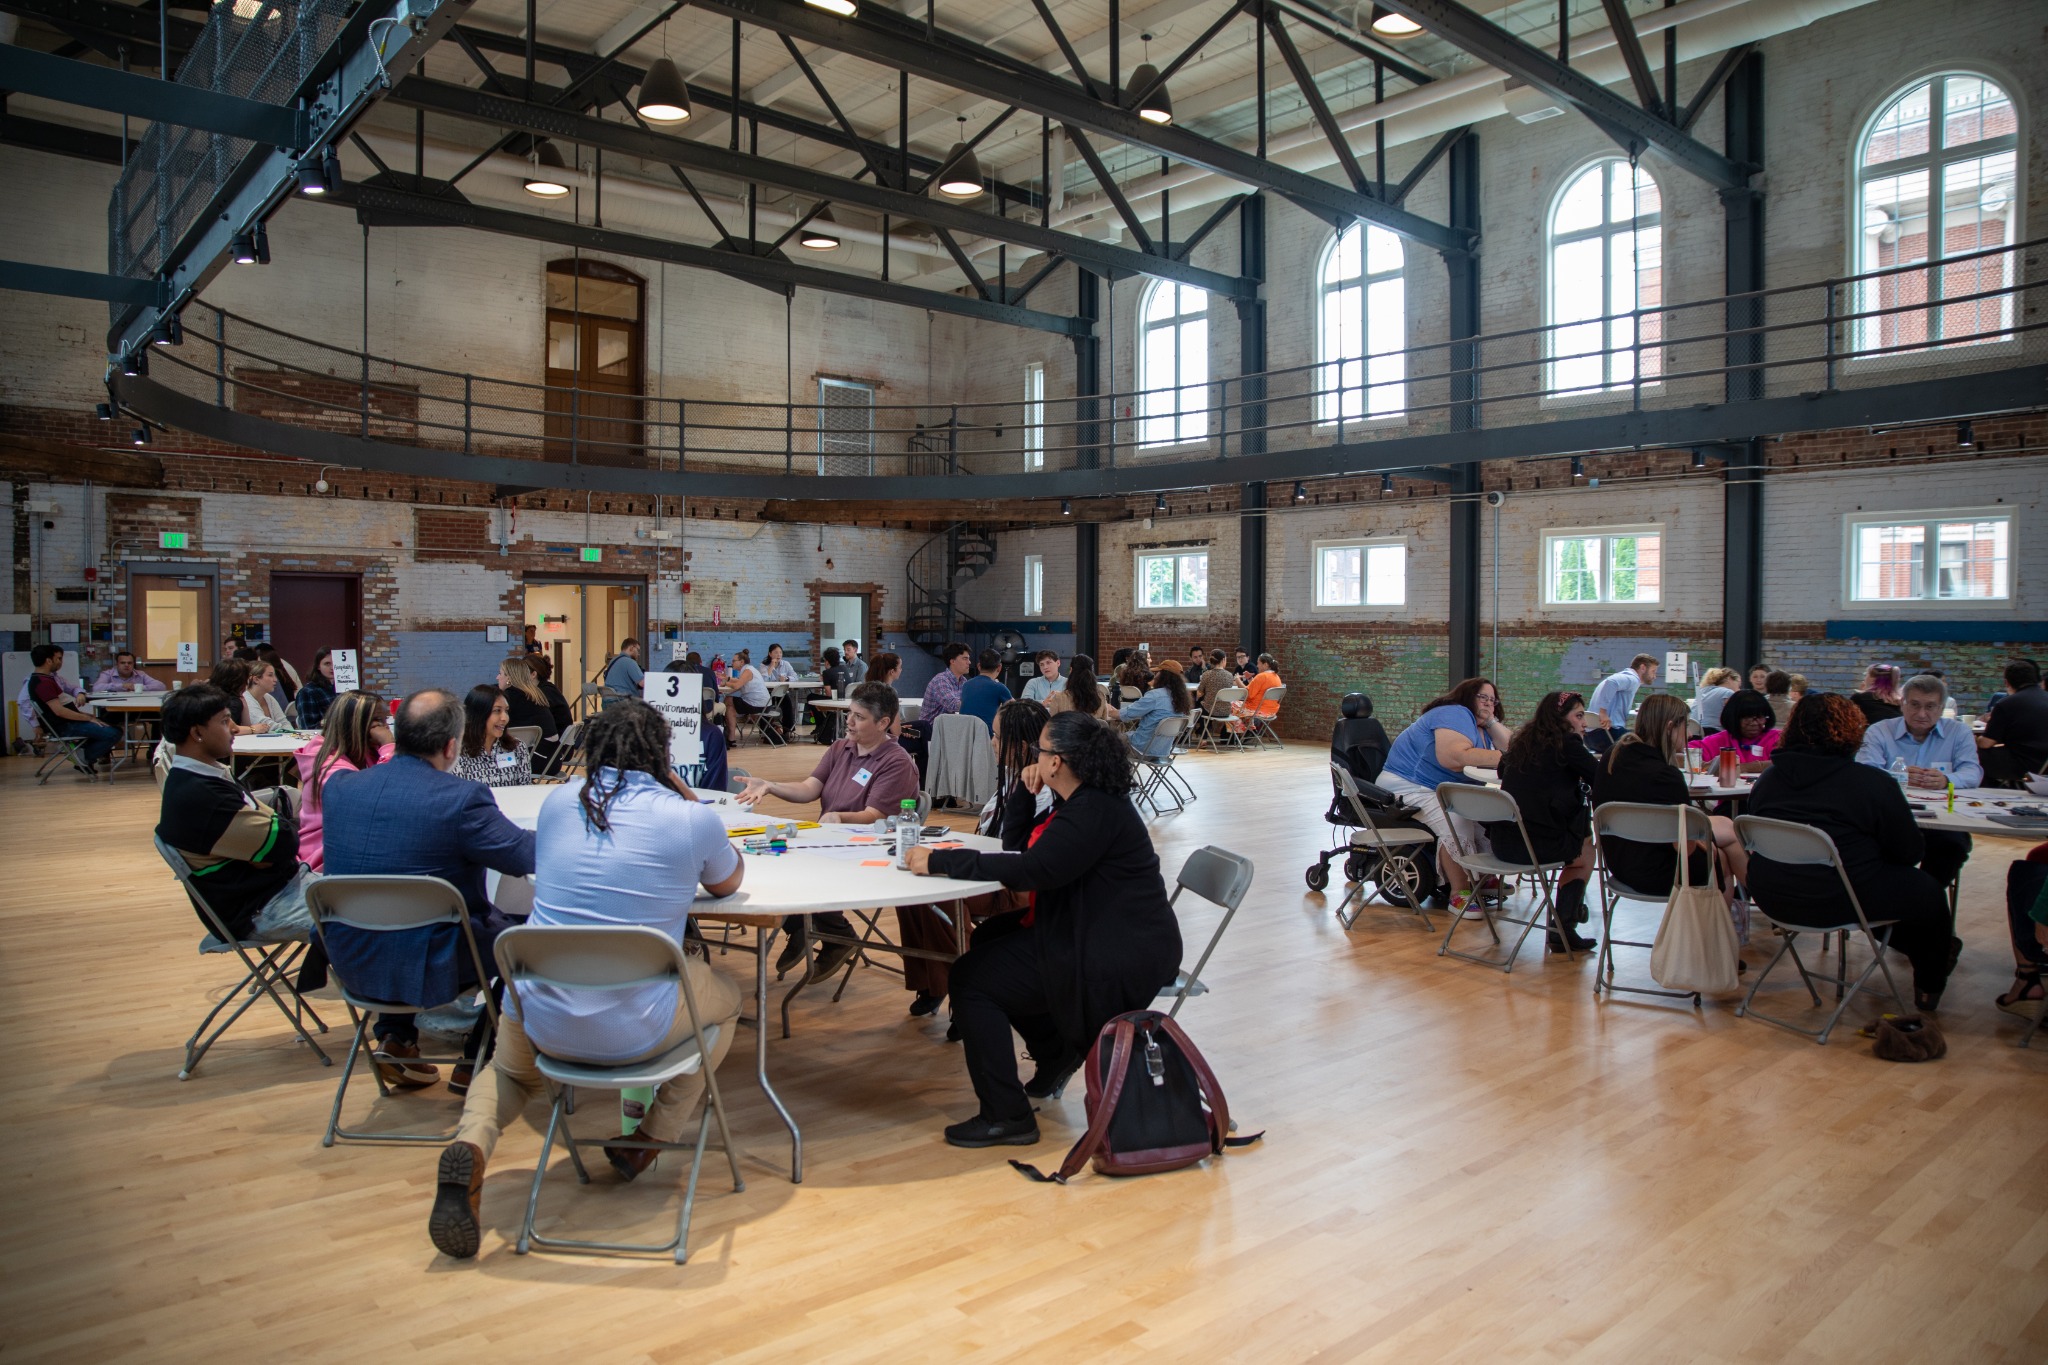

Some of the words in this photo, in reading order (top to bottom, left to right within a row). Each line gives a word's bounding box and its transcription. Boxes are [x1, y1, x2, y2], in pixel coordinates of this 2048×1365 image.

[164, 533, 184, 548] EXIT
[185, 643, 190, 651] 8
[342, 652, 346, 662] 5
[666, 676, 679, 697] 3
